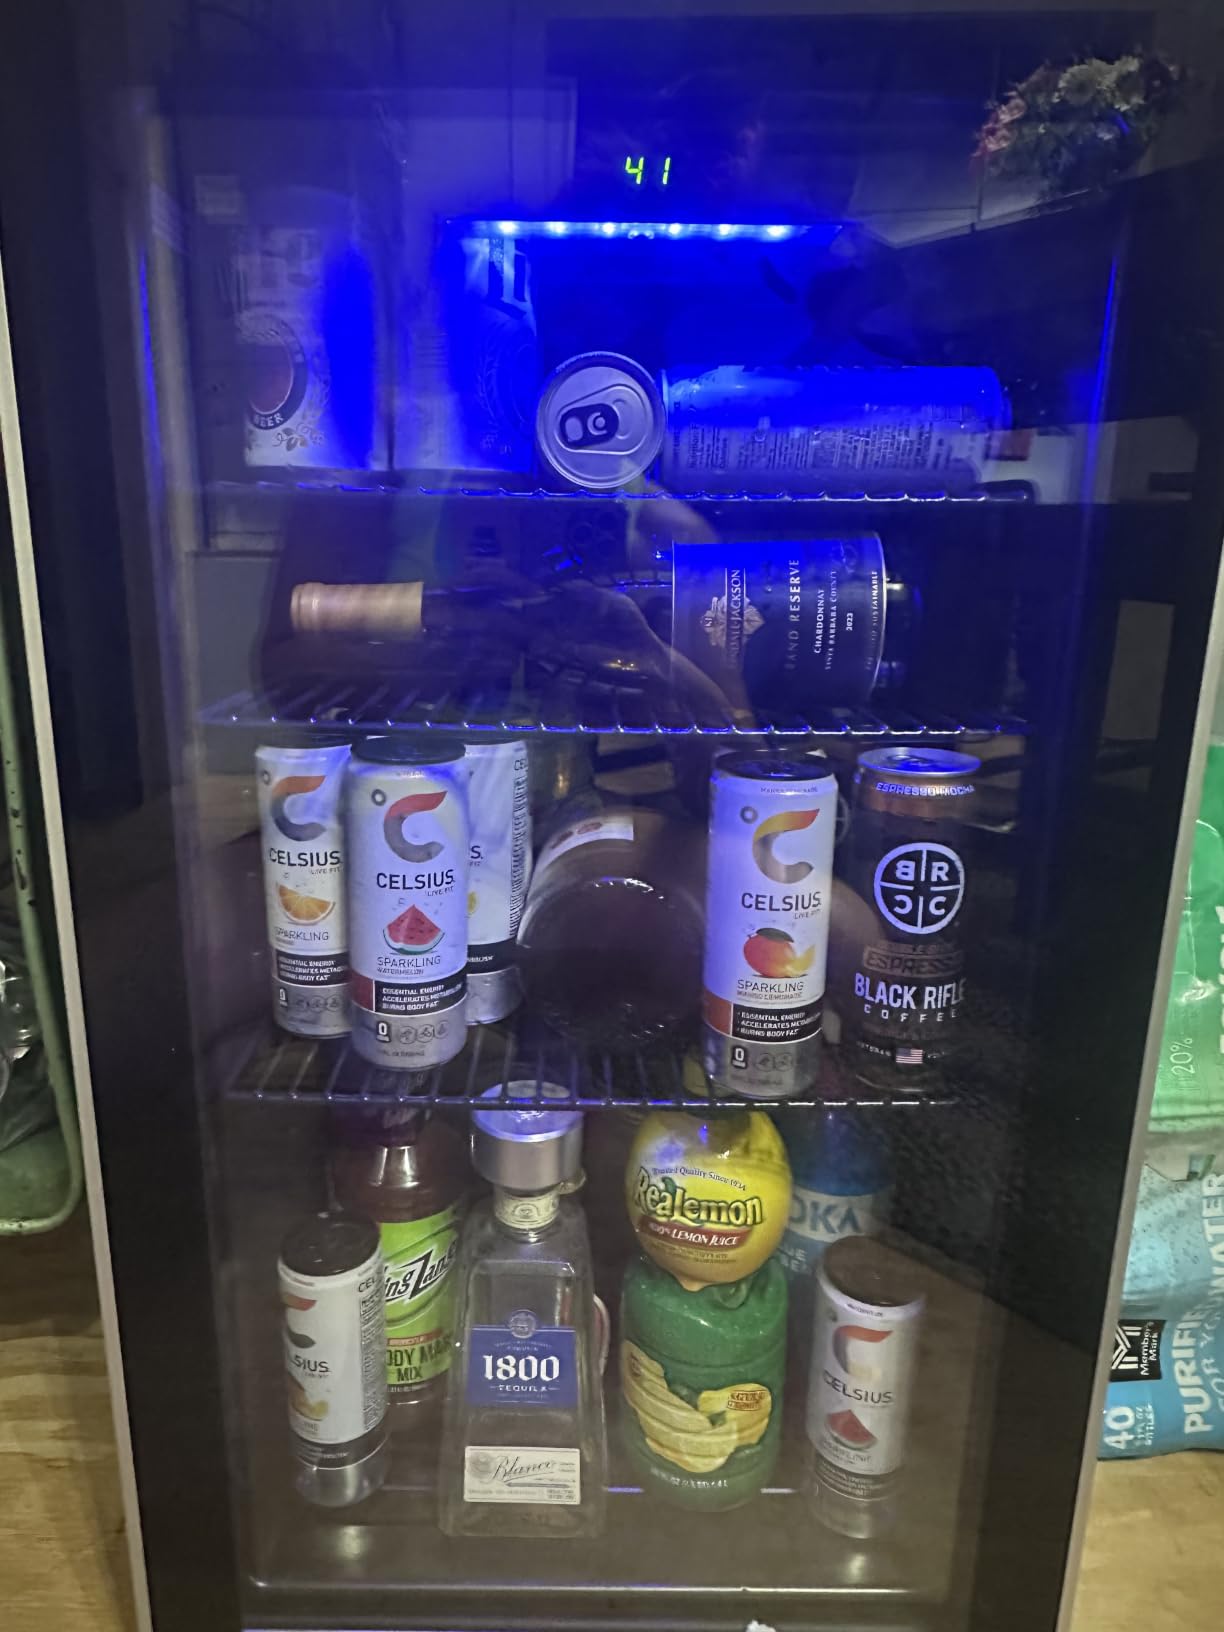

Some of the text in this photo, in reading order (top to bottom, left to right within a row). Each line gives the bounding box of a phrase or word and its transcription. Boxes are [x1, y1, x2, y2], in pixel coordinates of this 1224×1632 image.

[625, 156, 671, 185] 41
[788, 559, 801, 622] RESERVE
[729, 569, 742, 668] NDALL-JACKSON
[813, 589, 825, 654] CHARDONNAY
[269, 848, 340, 866] CELSIUS
[376, 869, 454, 890] CELSIUS
[741, 892, 822, 912] CELSIUS
[275, 926, 329, 941] SPARKLING
[377, 955, 441, 968] SPARKLING
[737, 979, 804, 993] SPARKLING
[855, 972, 917, 1010] BLACK
[864, 1004, 957, 1022] COFFEE
[1169, 1038, 1195, 1075] 20%
[680, 1166, 706, 1178] Quality
[672, 1227, 708, 1246] LEMON
[709, 1235, 739, 1247] JUICE
[1149, 1331, 1159, 1362] Mark
[289, 1355, 330, 1373] SIUS
[396, 1365, 423, 1382] MIX
[482, 1354, 560, 1382] 1800
[498, 1384, 548, 1393] TEQUILA
[823, 1370, 893, 1404] CELSIUS
[1103, 1406, 1136, 1450] 40
